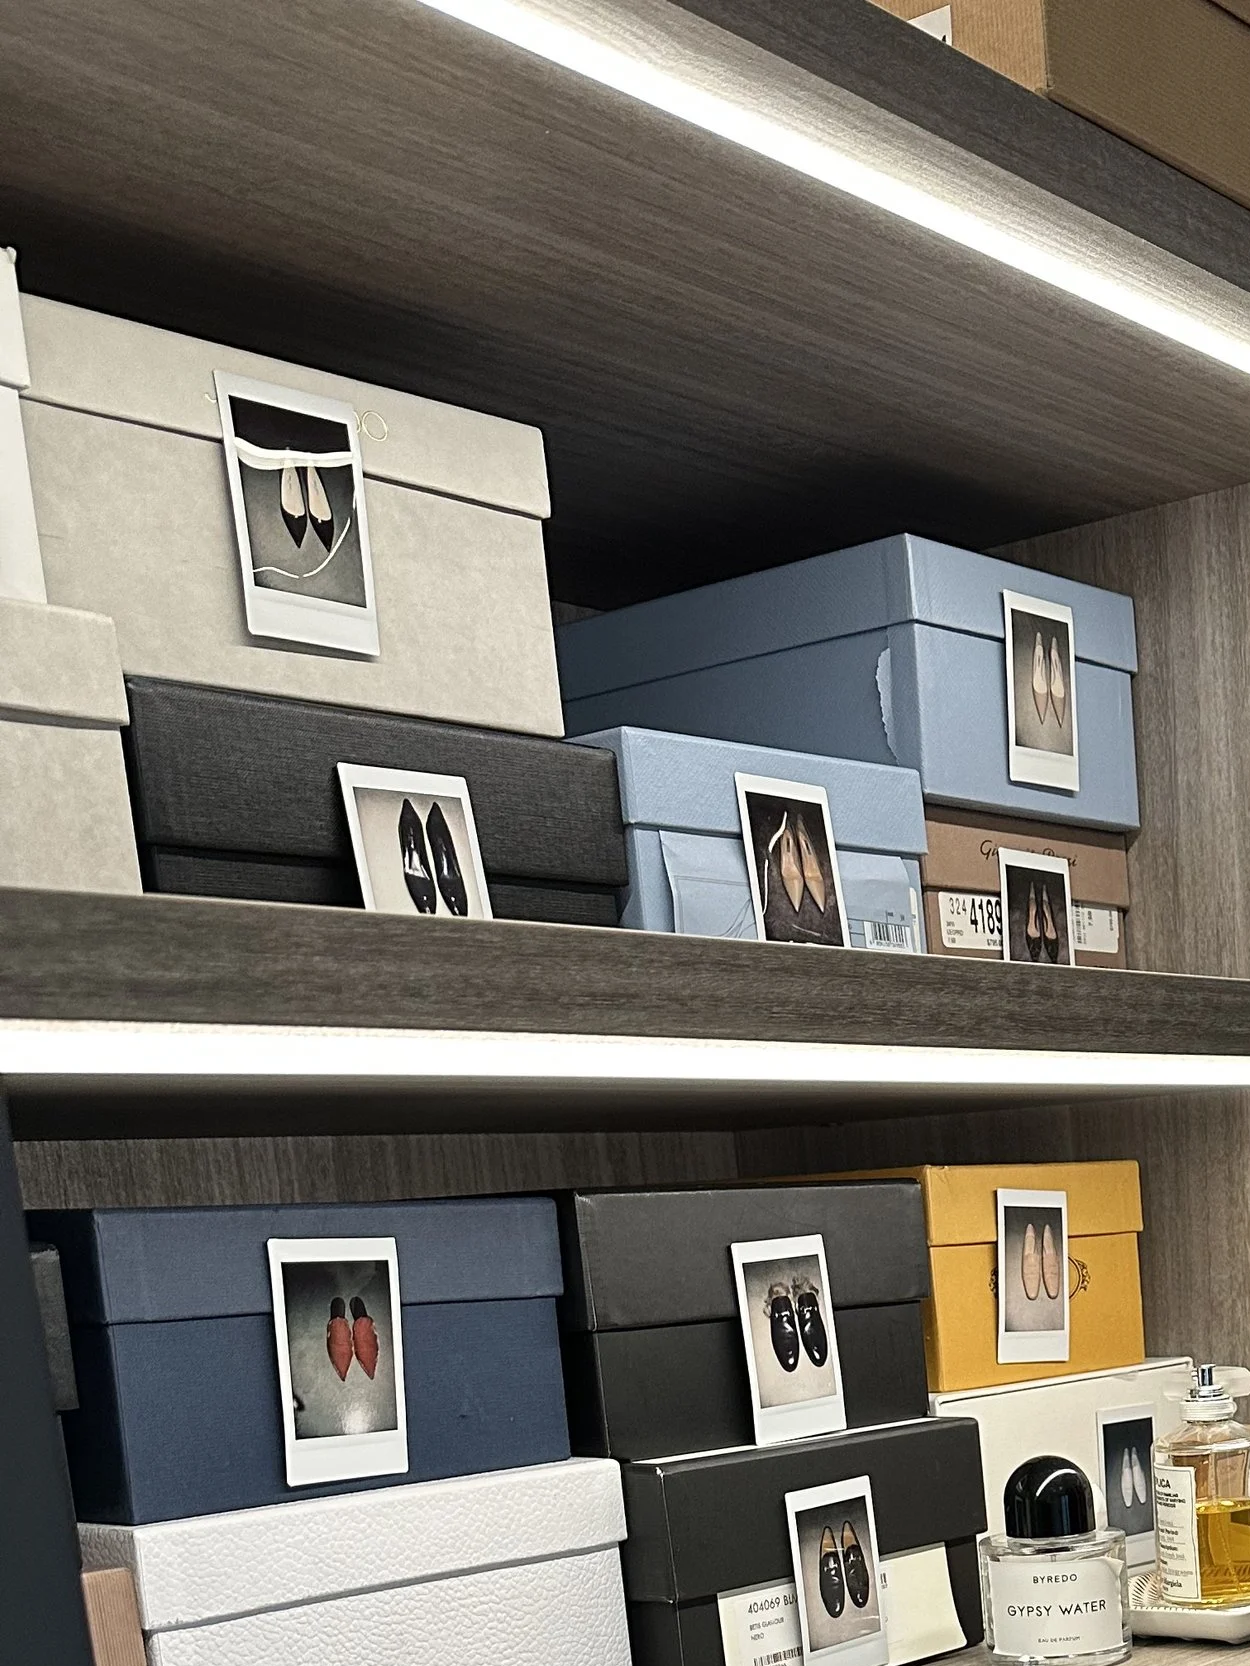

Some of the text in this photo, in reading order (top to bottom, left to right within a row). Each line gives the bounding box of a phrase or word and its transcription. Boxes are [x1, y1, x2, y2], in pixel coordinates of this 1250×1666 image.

[949, 896, 1003, 936] 324 4189
[1032, 1573, 1078, 1584] BYREDO
[748, 1597, 781, 1614] 404069
[1007, 1599, 1107, 1617] GYPSY WATER
